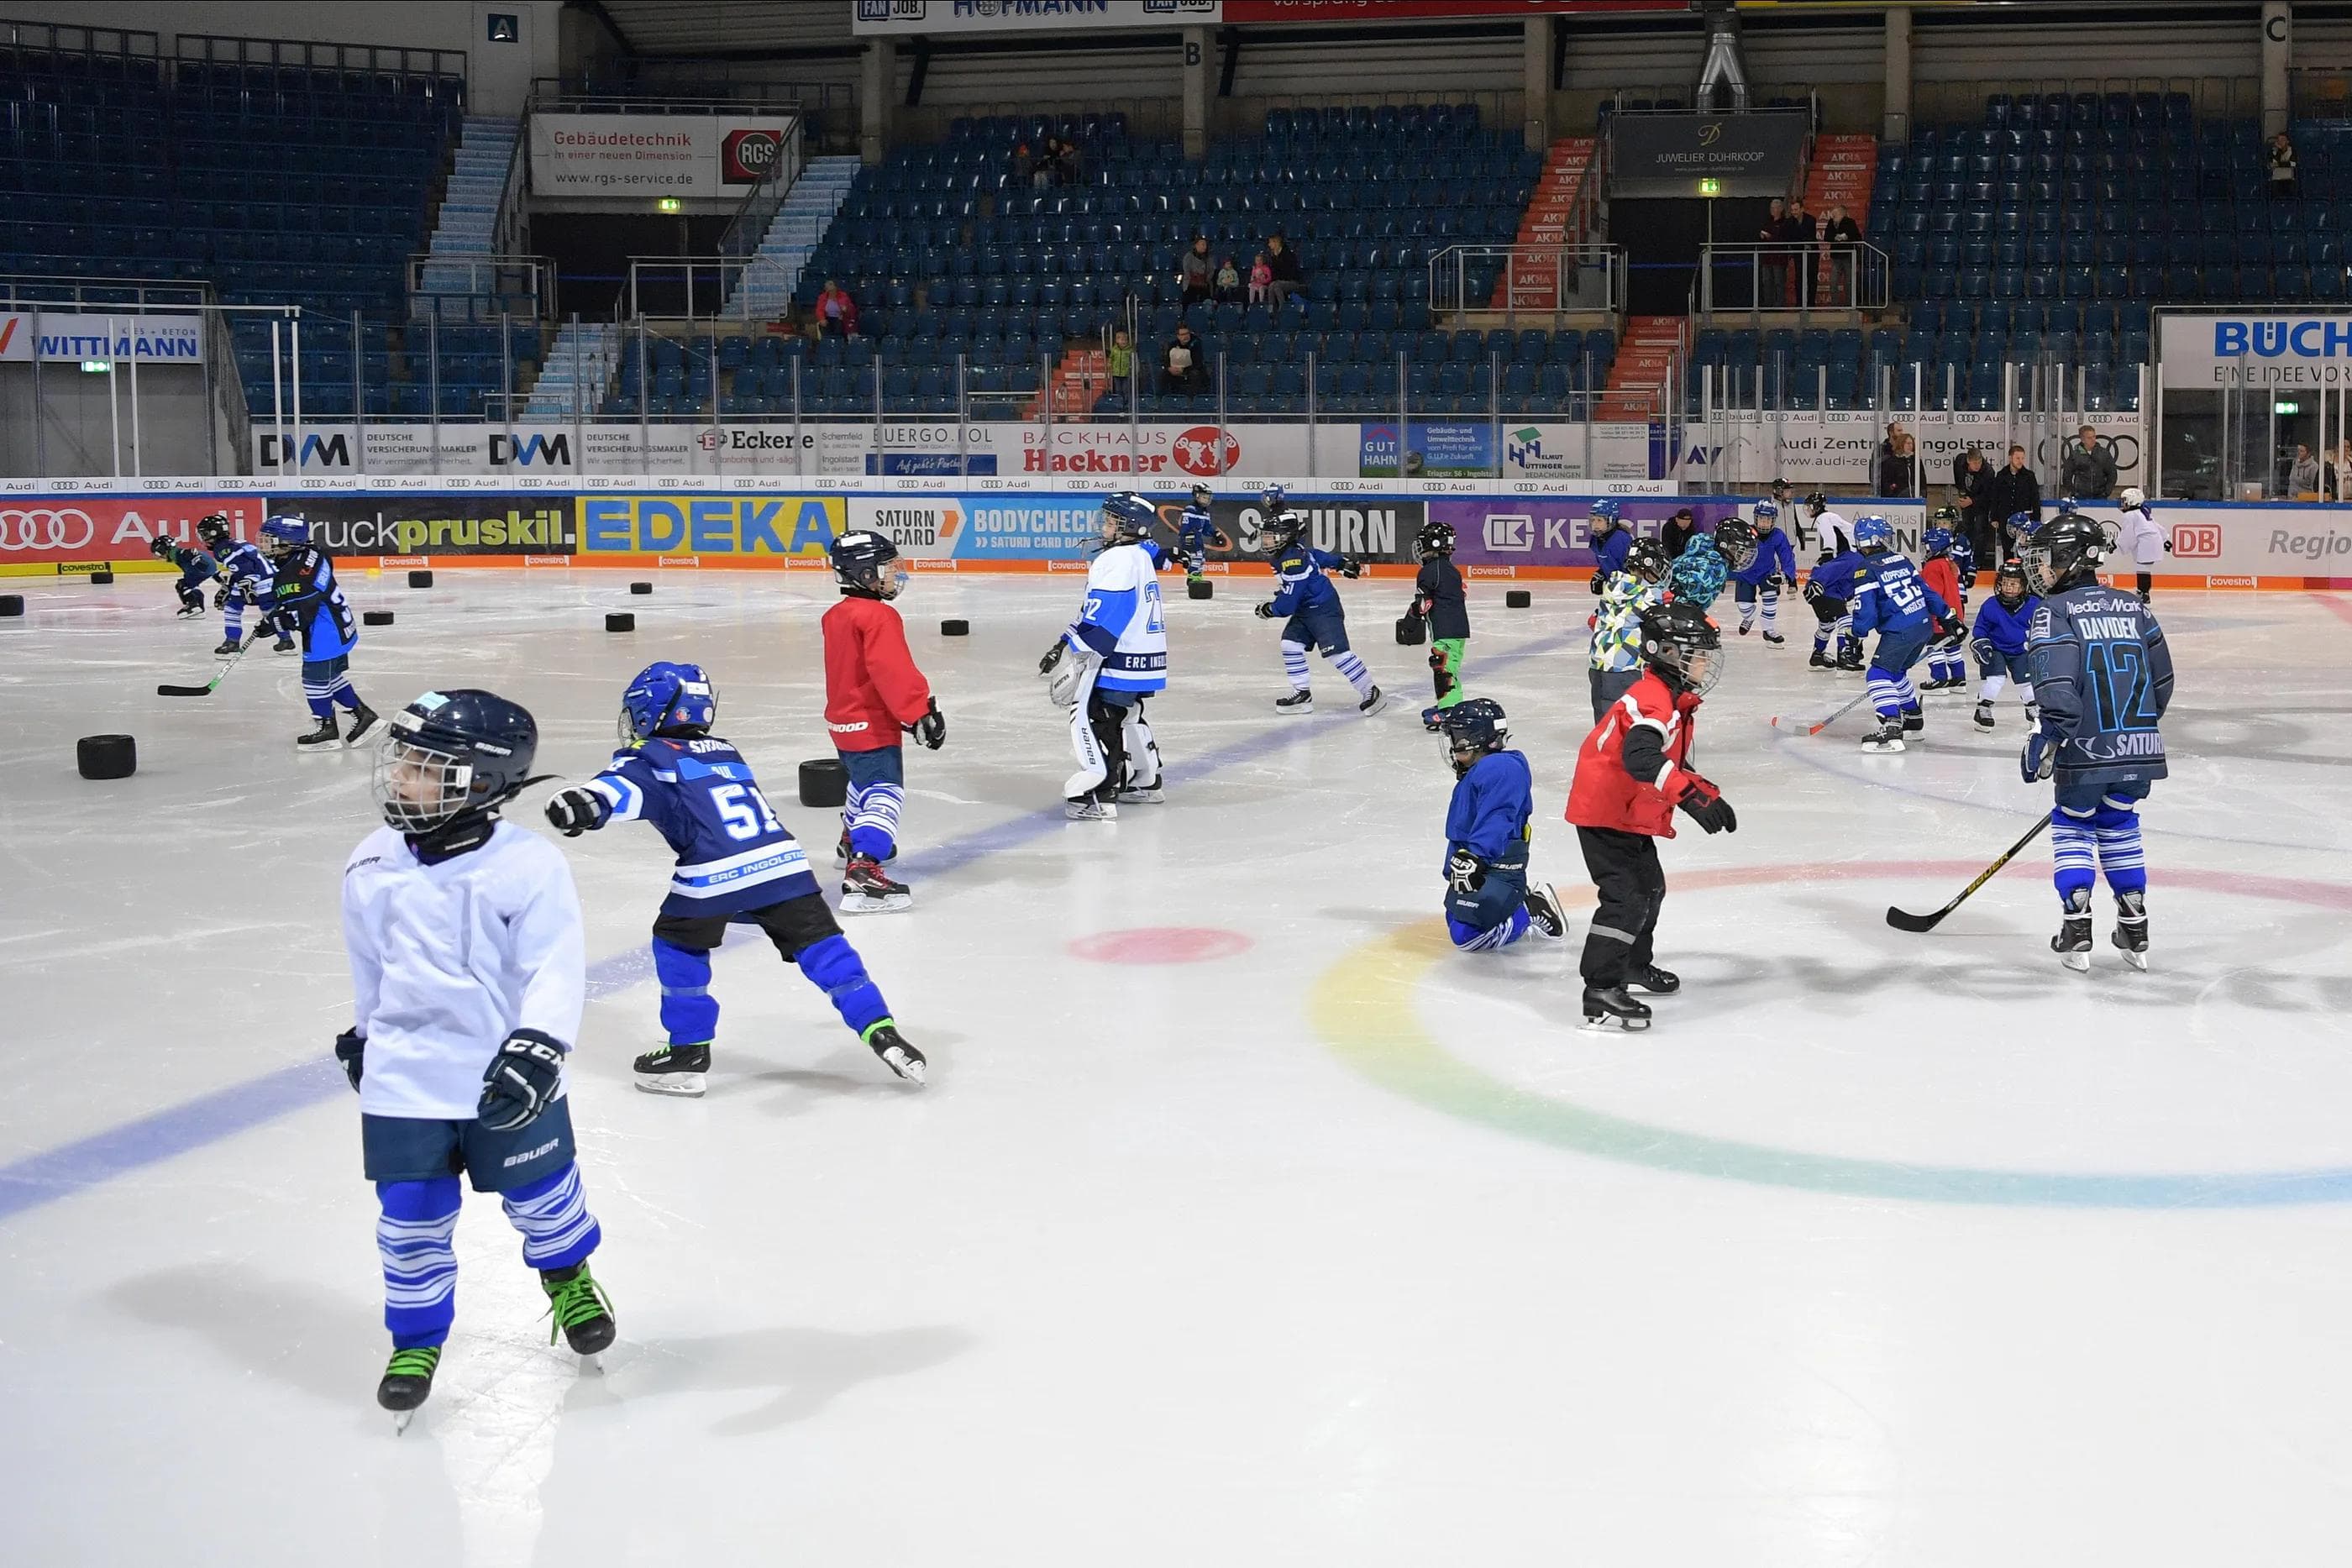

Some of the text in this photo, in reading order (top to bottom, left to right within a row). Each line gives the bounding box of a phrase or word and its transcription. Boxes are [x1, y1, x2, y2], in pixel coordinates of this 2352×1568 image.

[492, 18, 513, 39] A
[2266, 16, 2287, 42] C
[1186, 43, 1201, 66] B
[554, 131, 691, 147] Gebäudetechnik
[635, 151, 692, 160] Dimension
[742, 143, 774, 163] RGS
[1656, 153, 1704, 162] JUWELIER
[555, 173, 693, 186] www.rgs-service.de
[2214, 366, 2256, 383] ENE
[1793, 413, 1817, 422] Audi
[1854, 413, 1876, 422] Aud
[1919, 414, 1945, 422] Audi
[367, 433, 413, 442] DEUTSCHE
[732, 430, 814, 449] Eckere
[1023, 432, 1167, 444] BACKHAUS
[489, 433, 572, 466] DVM
[1824, 438, 1876, 450] Zentr
[822, 455, 860, 465] Ingolstadt
[1023, 448, 1168, 472] Hackner
[1364, 454, 1397, 465] HAHN
[6, 482, 35, 490] Audi
[84, 481, 113, 490] Audi
[175, 480, 203, 489] Audi
[249, 480, 276, 488] Audi
[328, 480, 356, 488] Audi
[401, 479, 427, 487] Audi
[475, 479, 500, 487] Audi
[546, 479, 570, 487] Audi
[613, 479, 636, 487] Audi
[683, 479, 705, 487] Audi
[759, 479, 781, 487] Audi
[1358, 482, 1383, 490] Audi
[1542, 483, 1568, 491] Audi
[1637, 484, 1663, 492] Audi
[875, 510, 935, 527] SATURN
[585, 500, 835, 553] EDEKA
[894, 529, 935, 547] CARD
[990, 537, 1062, 548] SATURN CARD
[2178, 529, 2215, 553] DB
[2268, 529, 2352, 560] Regio
[61, 562, 104, 572] covestro
[1052, 562, 1087, 570] covestro
[1472, 568, 1509, 576] covestro
[2210, 578, 2252, 586] covestro
[276, 583, 302, 598] JUKE
[2078, 617, 2141, 640] DAVIDEK
[1126, 656, 1147, 669] ERC
[2087, 642, 2158, 732] 12
[709, 869, 739, 884] ERC
[1966, 852, 2009, 896] BAUER
[504, 1138, 559, 1167] BAUER
